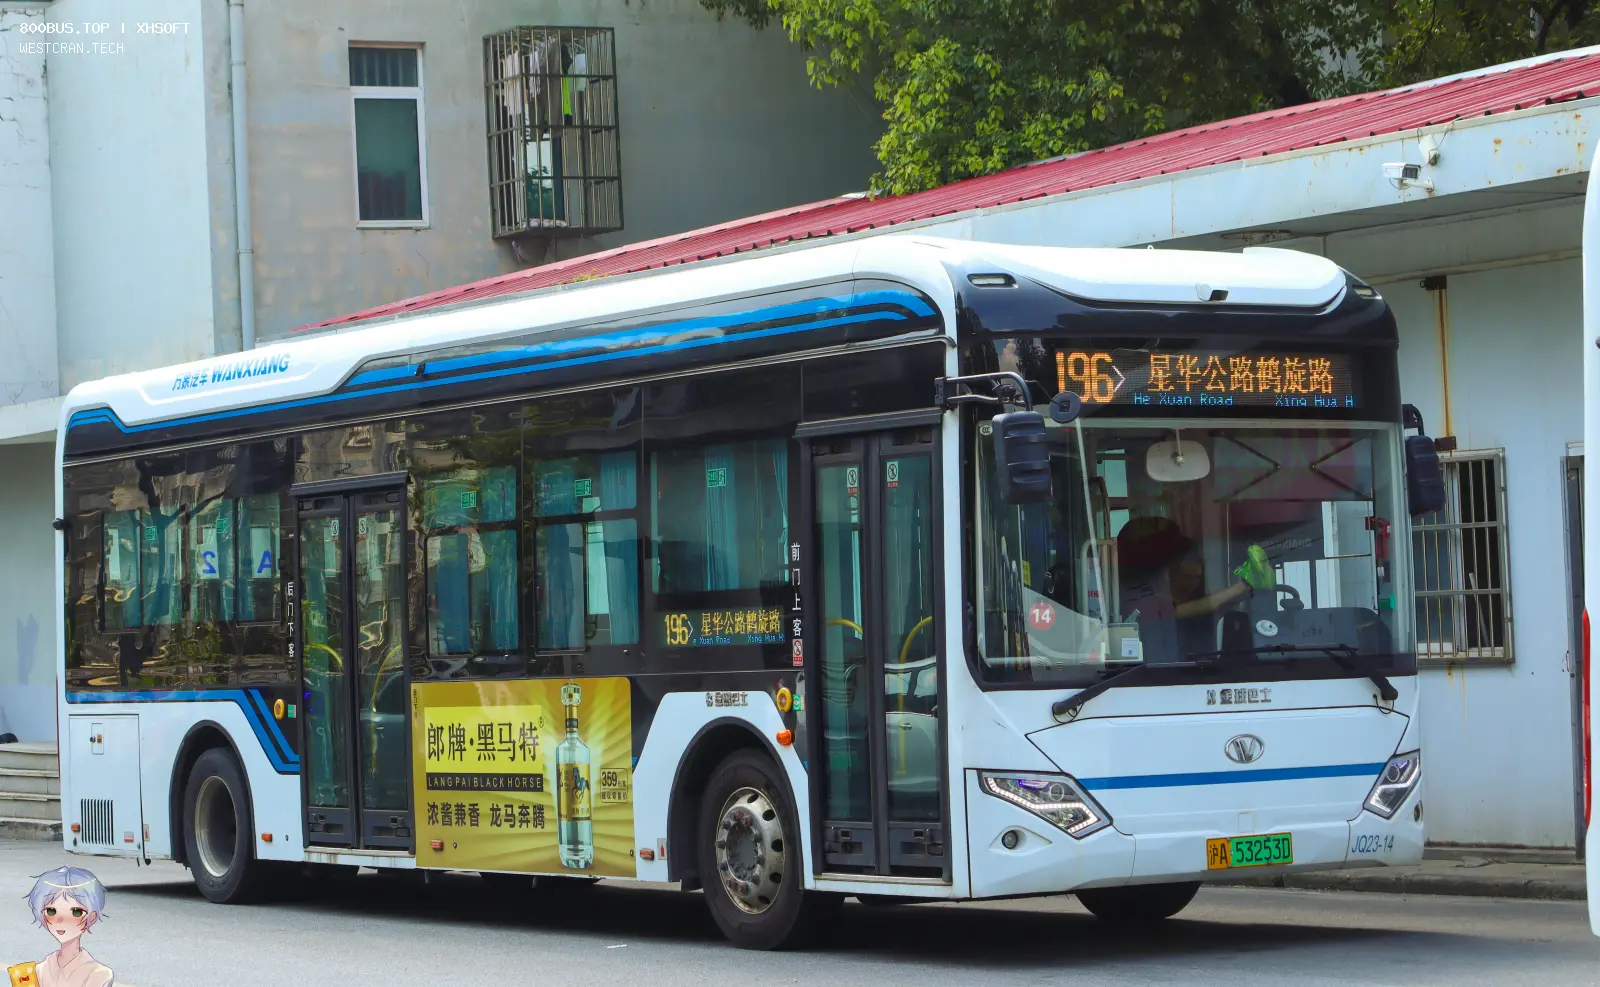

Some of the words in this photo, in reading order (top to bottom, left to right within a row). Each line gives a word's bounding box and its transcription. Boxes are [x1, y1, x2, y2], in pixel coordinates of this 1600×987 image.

[211, 353, 289, 383] WANXIANG
[1055, 352, 1113, 402] 196
[1147, 353, 1334, 393] 星华公路鹤旋路
[1133, 392, 1150, 404] He
[1159, 392, 1191, 405] Xuan
[1200, 392, 1233, 405] Road
[1314, 394, 1337, 406] Hua
[791, 542, 801, 636] 前门上客
[664, 613, 688, 644] 196
[700, 609, 780, 636] 星华公路鹤旋路
[1032, 608, 1050, 623] 14
[427, 802, 480, 827] 浓酱兼香
[489, 803, 545, 828] 龙马奔腾
[1351, 835, 1394, 852] JQ23-14
